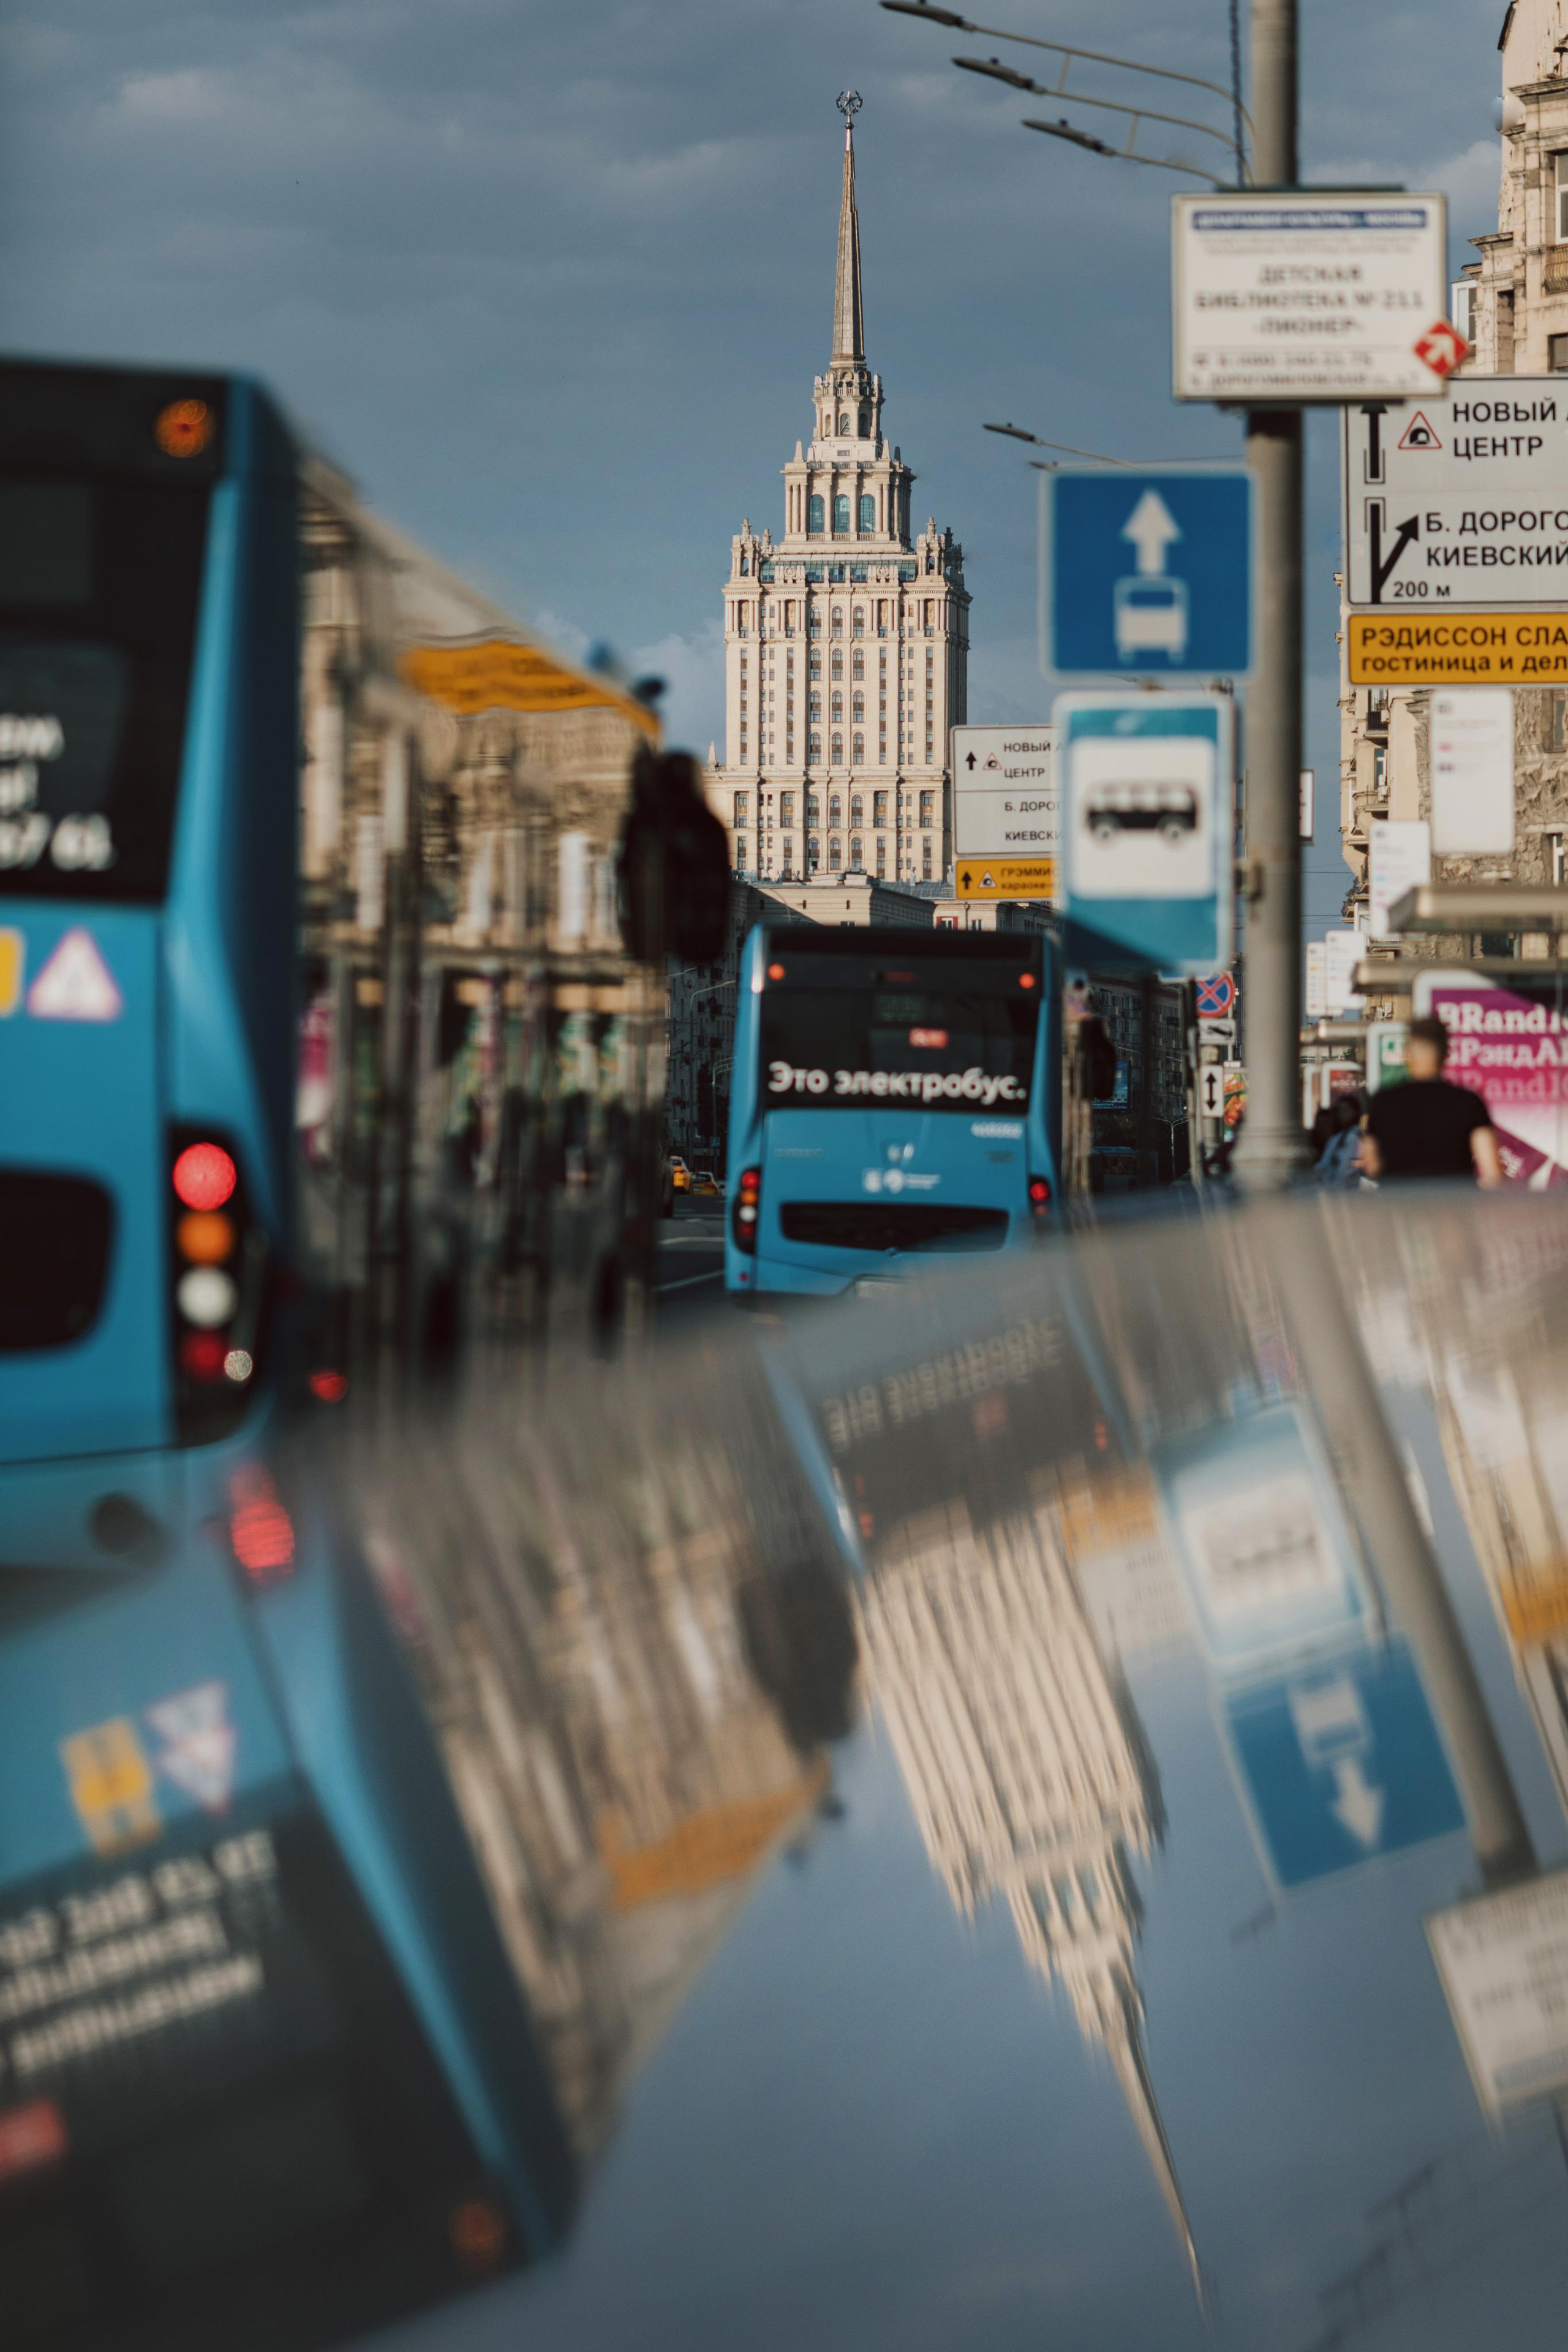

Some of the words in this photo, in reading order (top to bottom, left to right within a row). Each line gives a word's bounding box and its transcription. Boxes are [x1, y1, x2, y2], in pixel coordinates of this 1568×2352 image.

[1453, 396, 1556, 423] НОВЫЙ
[1453, 435, 1543, 461] ЦЕНТР
[1426, 512, 1450, 532] Б.
[1393, 581, 1428, 597] 200
[1436, 585, 1450, 597] м
[1362, 627, 1506, 649] РЭДИССОН
[1362, 655, 1491, 673] гостиница
[1500, 657, 1513, 669] и
[1004, 741, 1051, 752] НОВЫЙ
[1005, 768, 1045, 778] ЦЕНТР
[1005, 802, 1016, 812] Б.
[768, 1061, 829, 1093] Это
[834, 1067, 1027, 1104] электробус.
